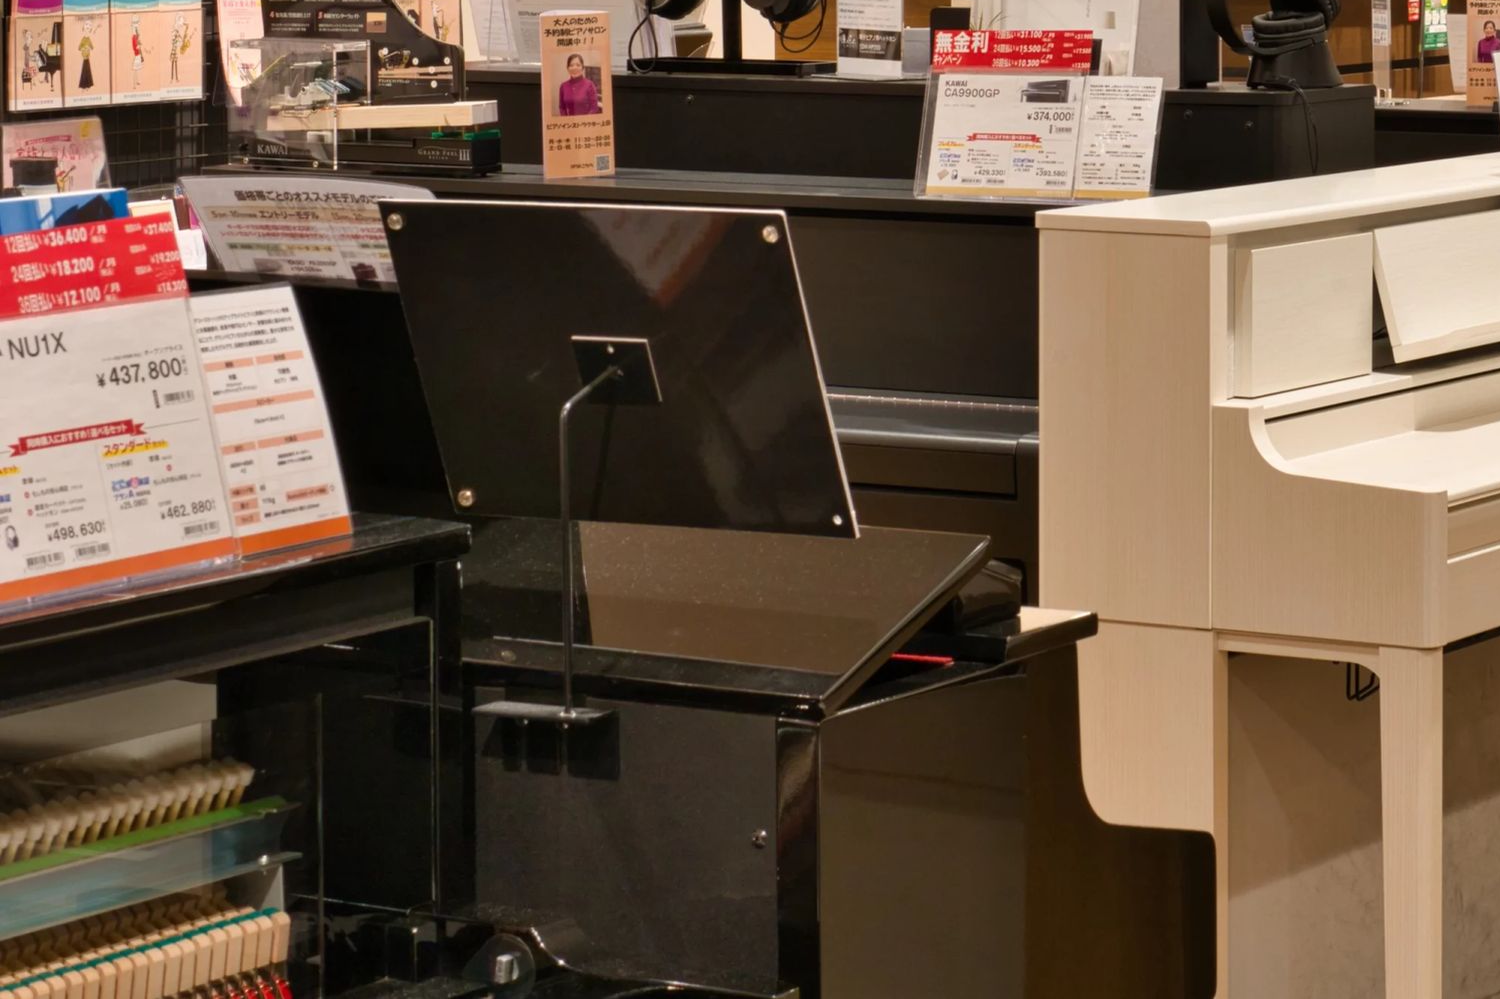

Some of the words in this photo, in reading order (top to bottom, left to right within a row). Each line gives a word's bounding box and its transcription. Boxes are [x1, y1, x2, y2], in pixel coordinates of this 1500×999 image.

[553, 17, 599, 27] 大人のための
[544, 25, 607, 38] 予約制ピアノサロン
[935, 31, 990, 54] 無金利
[944, 87, 1000, 98] CA9900GP
[257, 143, 288, 156] KAWAI
[8, 331, 67, 360] NU1X
